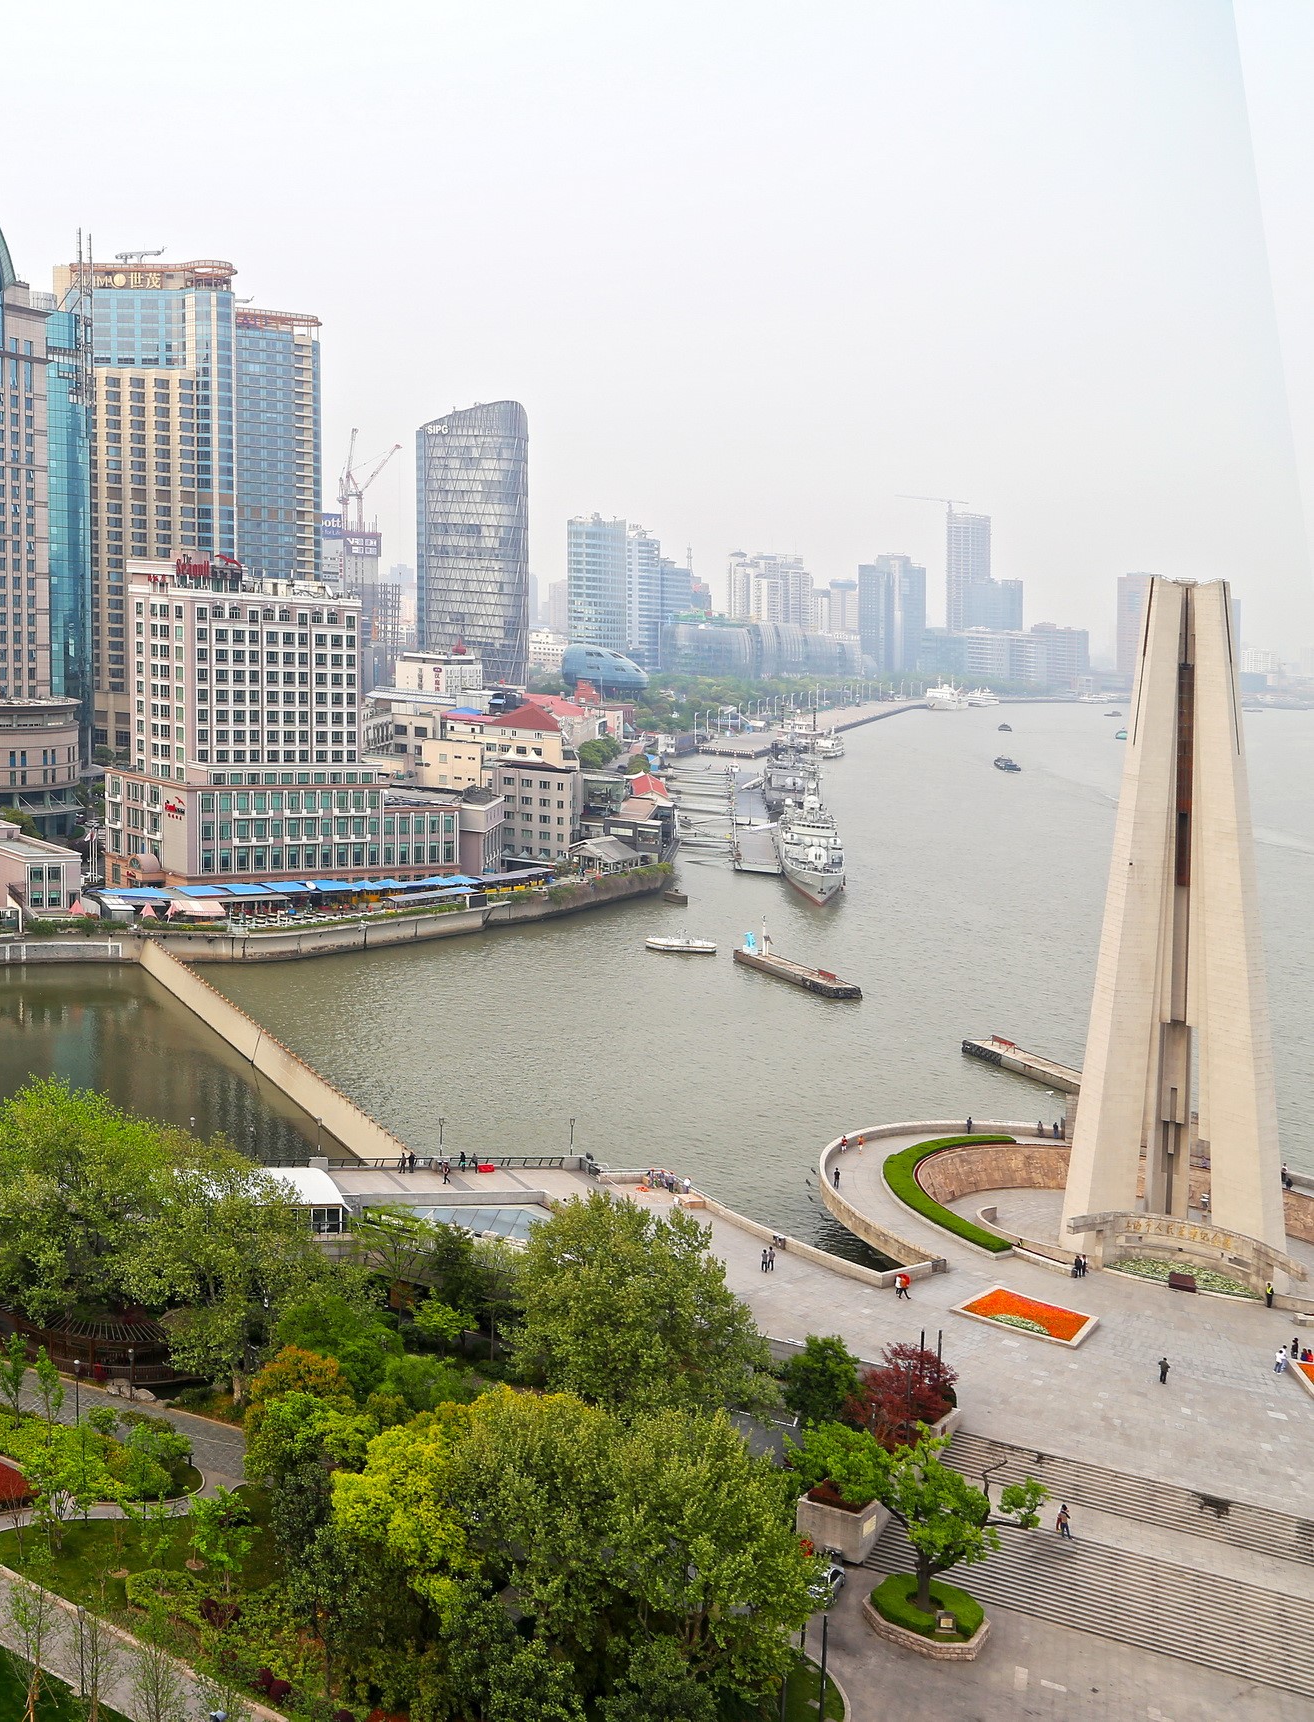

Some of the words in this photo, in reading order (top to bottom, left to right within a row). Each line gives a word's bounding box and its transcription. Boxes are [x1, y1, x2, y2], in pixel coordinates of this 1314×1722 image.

[129, 272, 161, 289] 世茂
[426, 424, 449, 435] SIPG
[322, 517, 342, 528] ott
